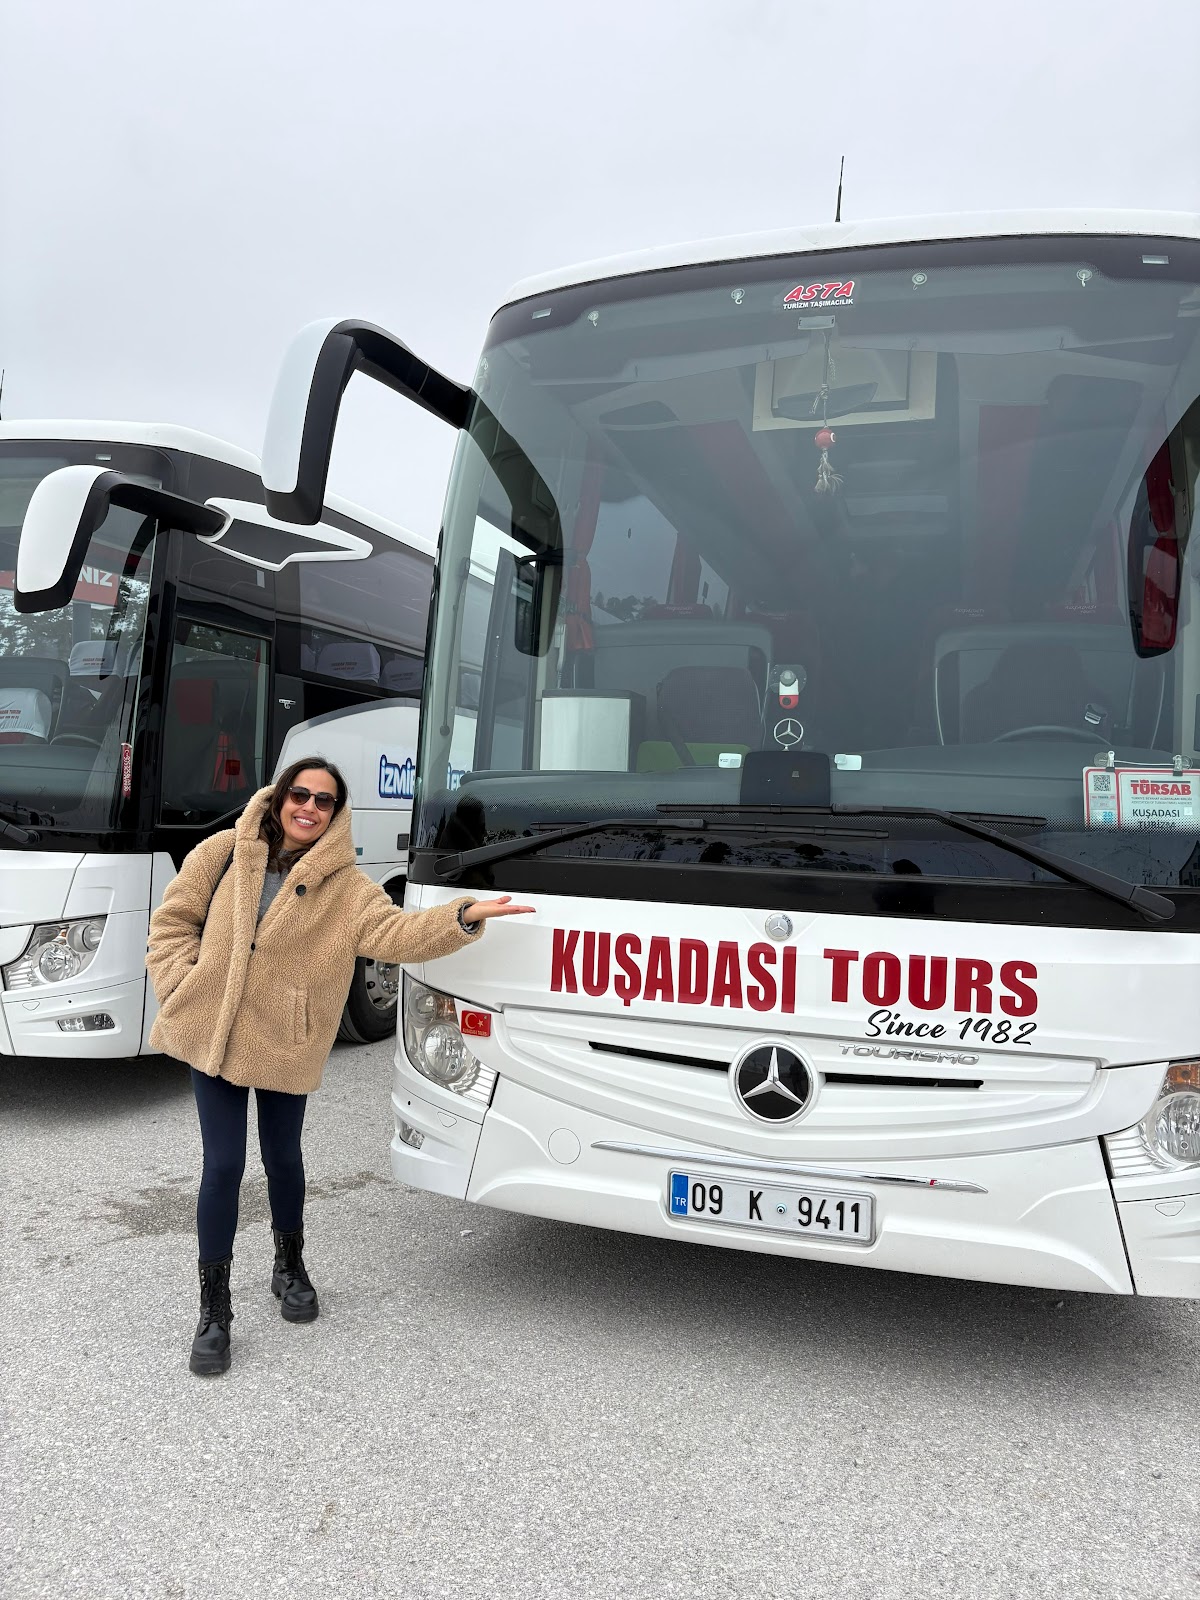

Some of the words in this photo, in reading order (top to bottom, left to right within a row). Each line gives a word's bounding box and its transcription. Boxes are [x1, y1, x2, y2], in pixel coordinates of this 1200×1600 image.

[784, 281, 855, 302] ASTA
[783, 302, 809, 310] TURİZM
[810, 299, 853, 307] TAŞIMACILIK
[1130, 779, 1192, 796] TÜRSAB
[1132, 808, 1180, 819] KUŞADASI
[550, 928, 797, 1014] KUŞADASI
[823, 948, 1038, 1017] TOURS
[865, 1009, 946, 1038] Since
[958, 1017, 1037, 1045] 1982
[838, 1043, 980, 1065] TOURISMO
[674, 1197, 687, 1207] TR
[692, 1182, 723, 1215] 09
[749, 1190, 763, 1221] K
[798, 1196, 861, 1233] 9411
